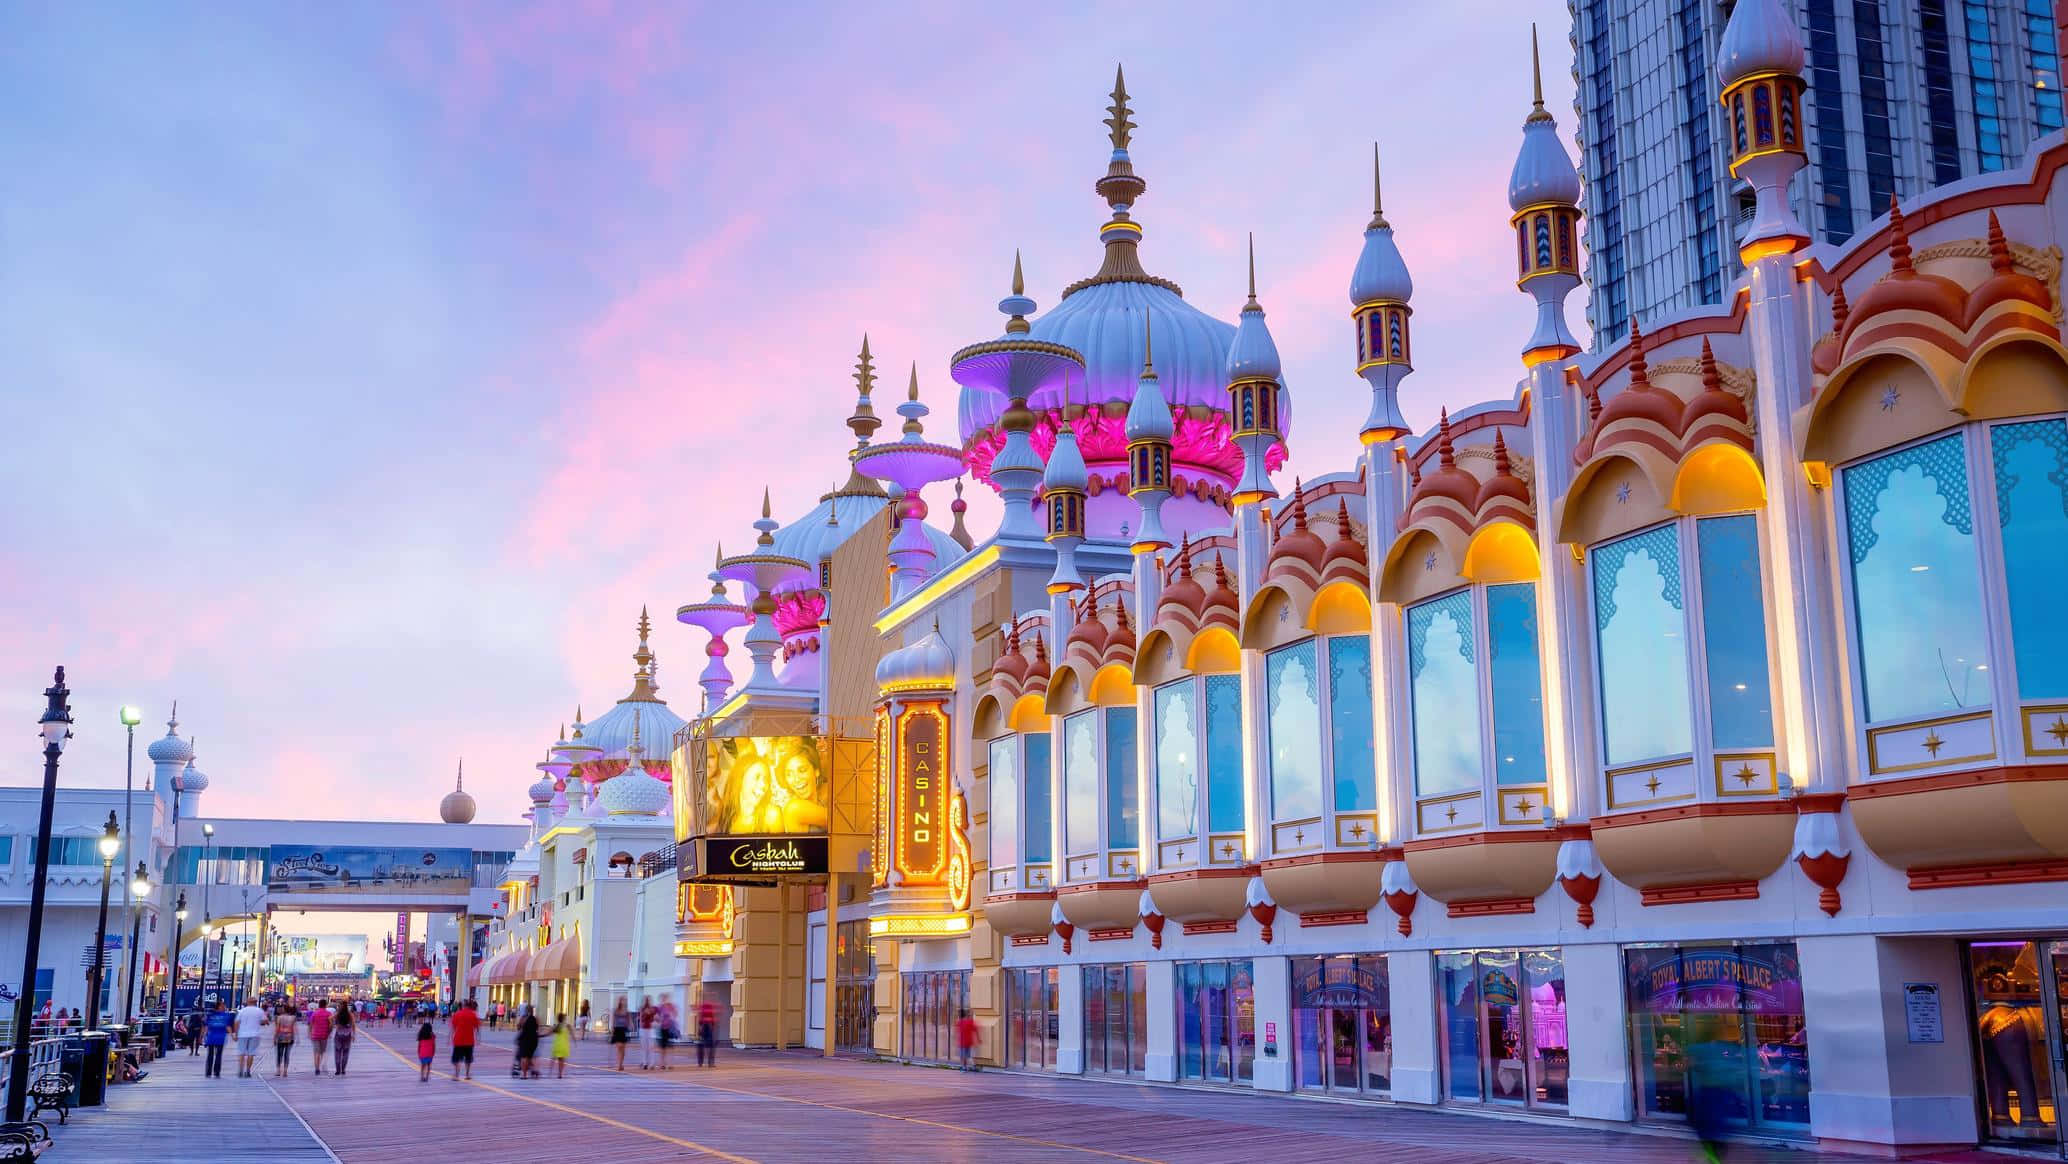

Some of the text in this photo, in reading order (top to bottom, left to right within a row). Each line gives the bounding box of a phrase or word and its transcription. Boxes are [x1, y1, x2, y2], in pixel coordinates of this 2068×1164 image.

[914, 742, 930, 842] CASINO
[730, 840, 800, 868] Casbah
[1652, 965, 1680, 992] ROYAL
[1731, 961, 1772, 990] PALACE
